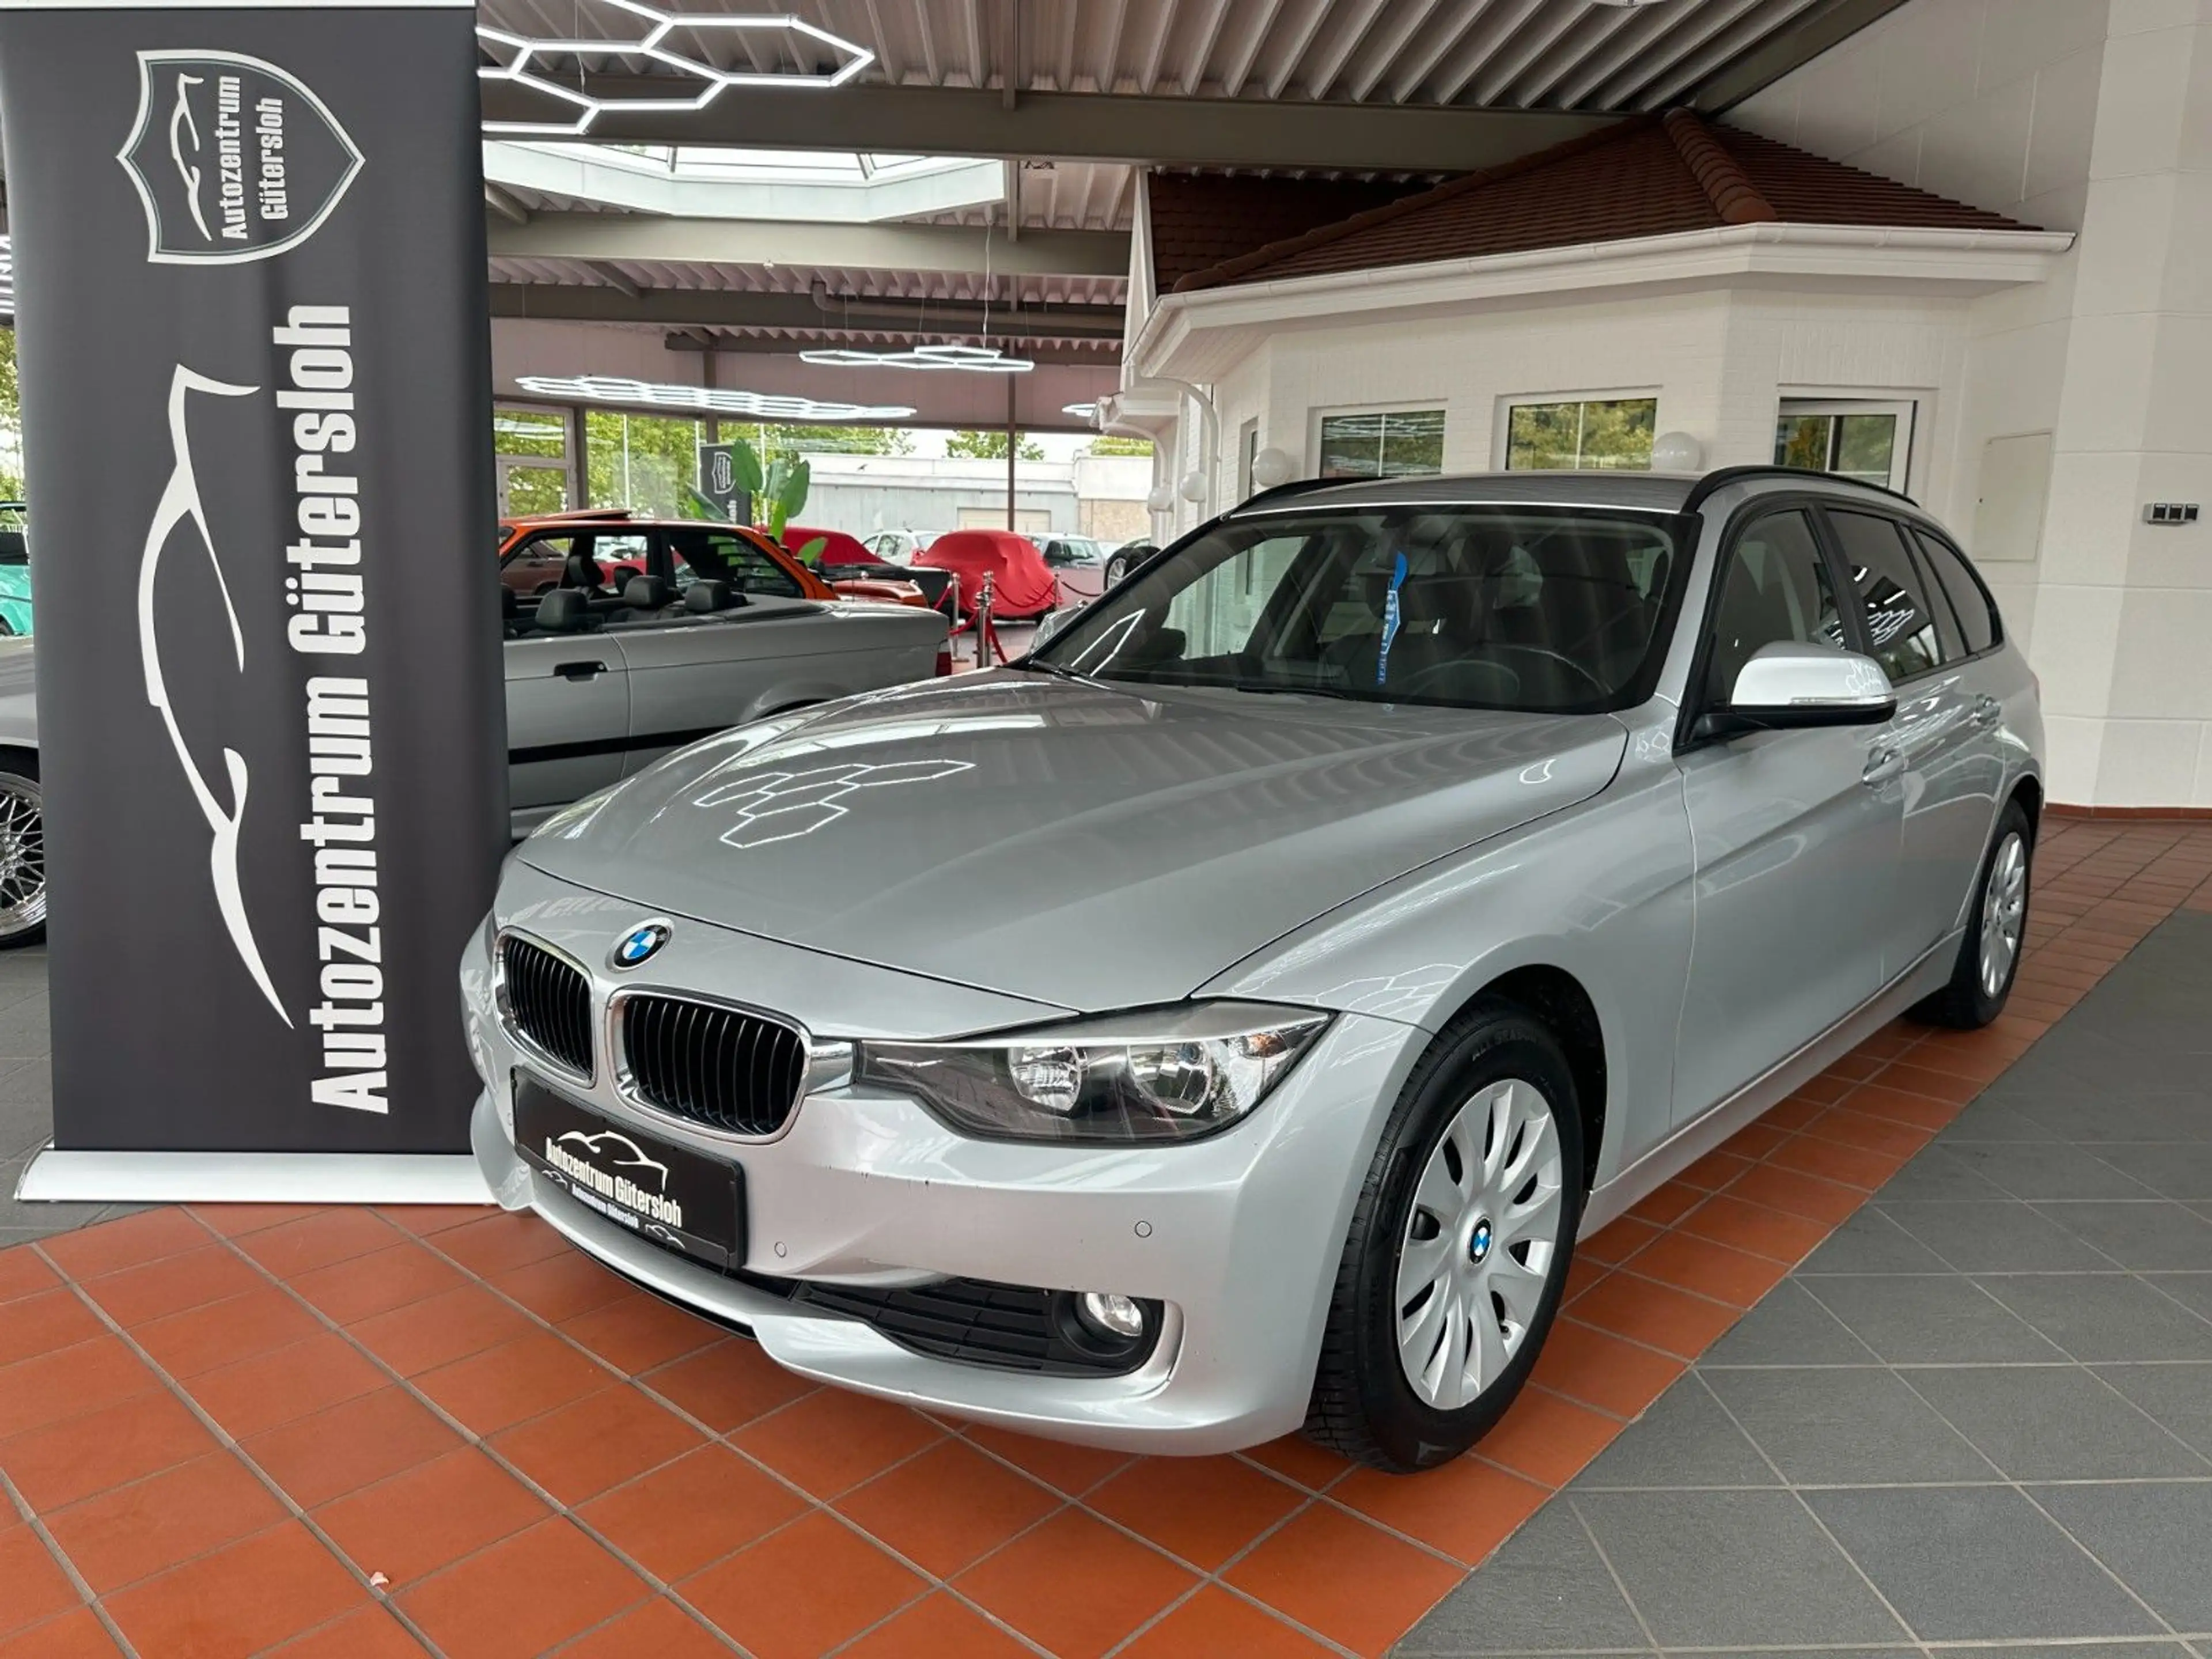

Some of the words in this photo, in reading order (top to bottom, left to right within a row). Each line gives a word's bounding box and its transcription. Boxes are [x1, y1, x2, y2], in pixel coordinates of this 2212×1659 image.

[214, 75, 248, 239] Autozentrum
[256, 97, 289, 219] Gütersloh
[273, 305, 366, 655] Gütersloh
[300, 676, 389, 1114] Autozentrum
[546, 1136, 613, 1198] Autozentrum
[615, 1175, 682, 1228] Gütersloh
